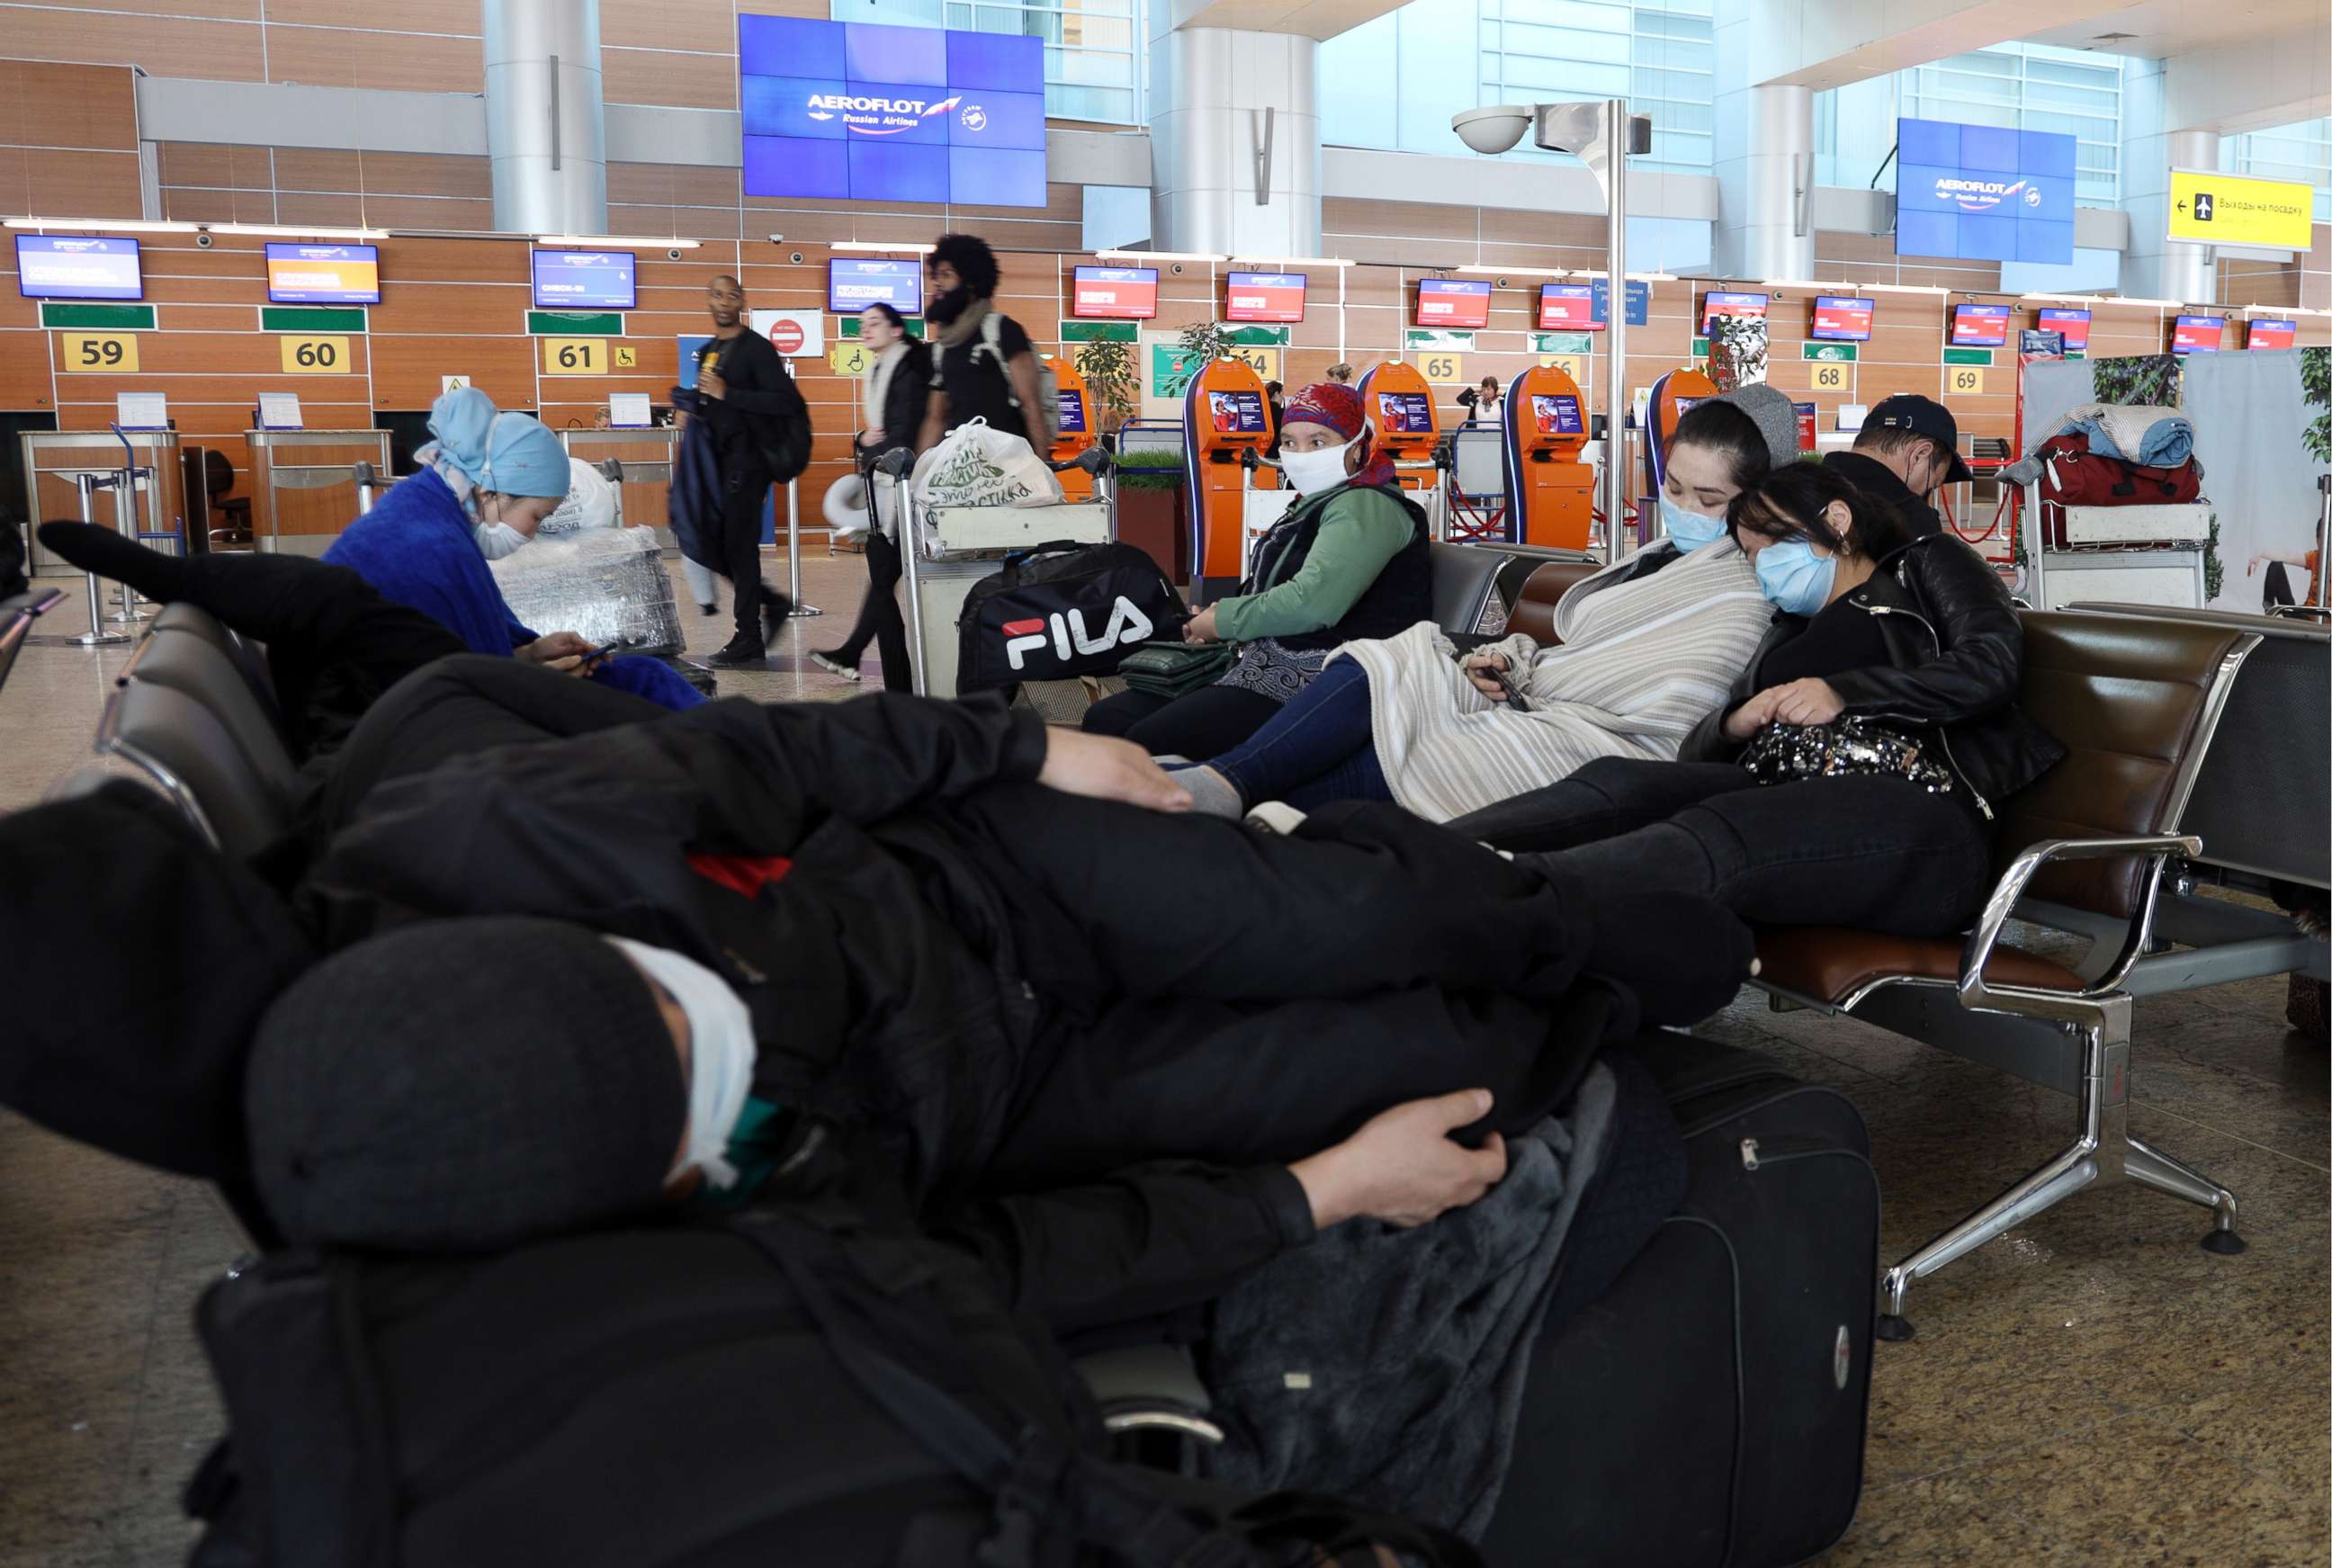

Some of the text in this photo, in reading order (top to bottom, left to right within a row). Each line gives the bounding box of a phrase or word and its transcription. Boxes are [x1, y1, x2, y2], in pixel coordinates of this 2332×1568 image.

[807, 94, 926, 114] AEROFLOT
[842, 113, 919, 128] Russian Airlines
[1935, 178, 2005, 193] AEROFLOT
[2219, 197, 2255, 211] Выходы
[81, 339, 124, 366] 59
[296, 342, 336, 367] 60
[558, 345, 591, 368] 61
[1428, 357, 1454, 378] 65
[1818, 367, 1840, 386] 68
[1956, 372, 1977, 389] 69
[1001, 595, 1154, 670] FILA
